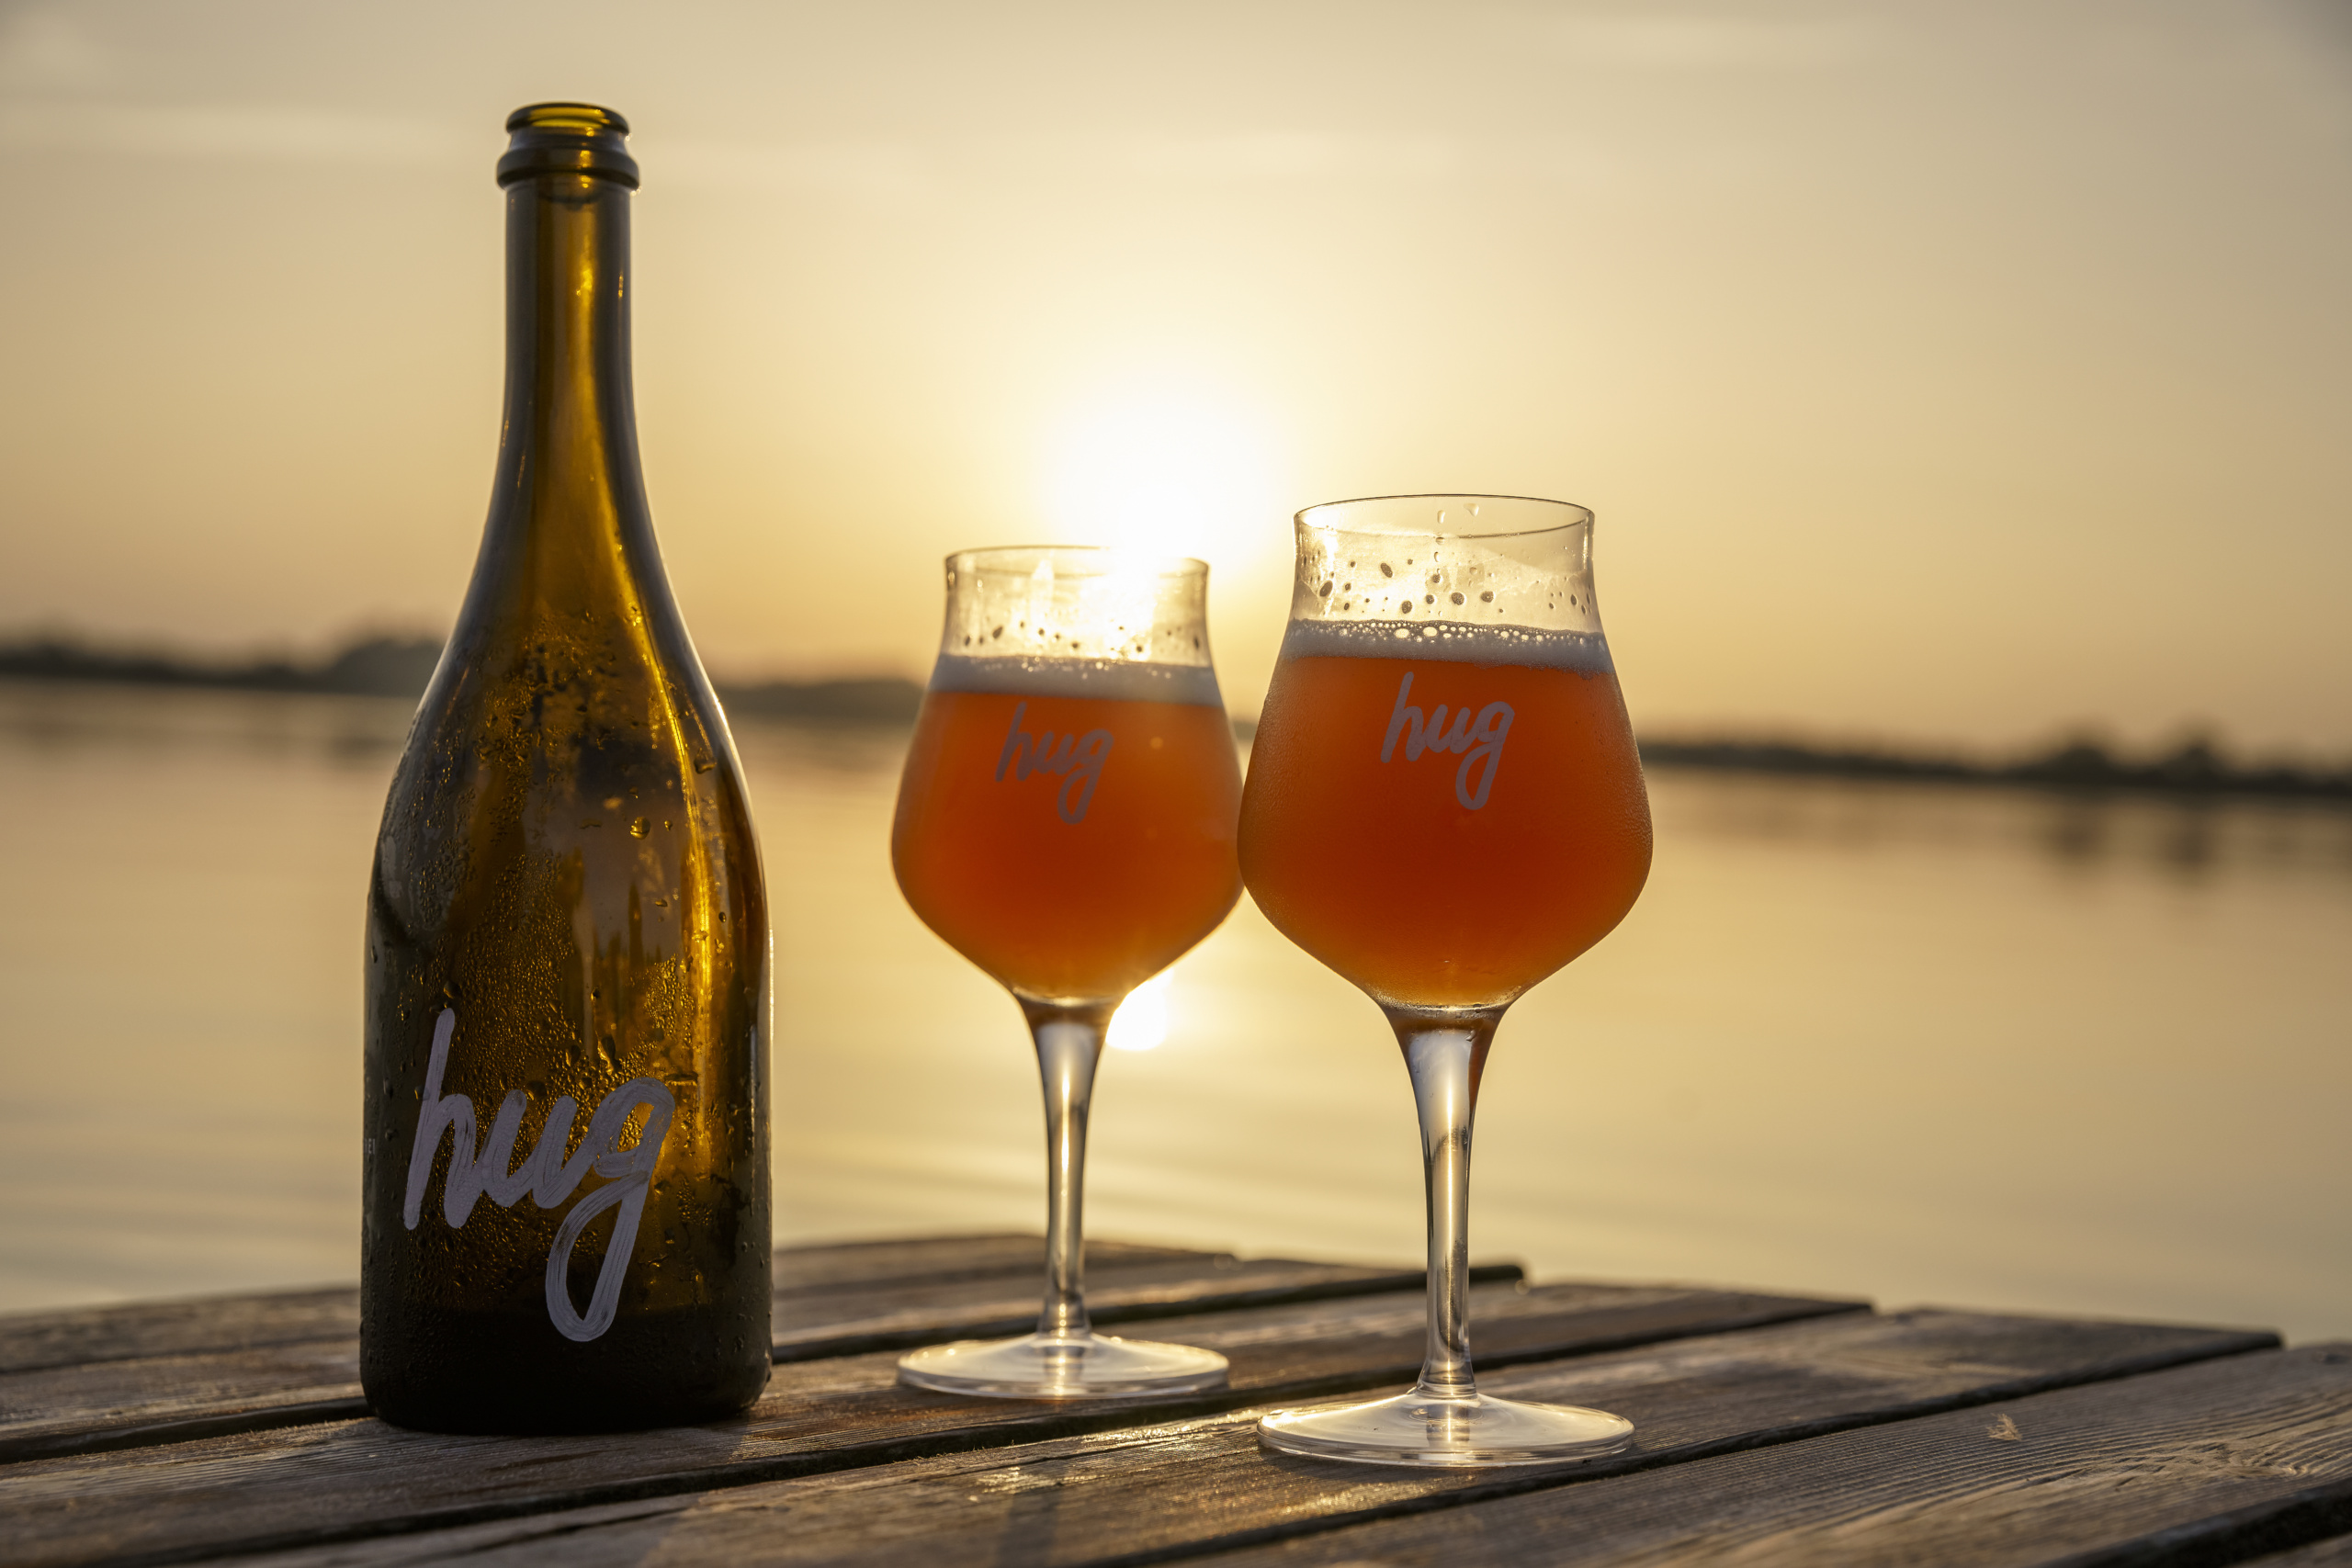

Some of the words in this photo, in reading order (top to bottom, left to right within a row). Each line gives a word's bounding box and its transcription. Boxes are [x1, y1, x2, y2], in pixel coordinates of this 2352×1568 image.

[994, 701, 1114, 825] hug
[1380, 671, 1515, 810] hug
[403, 1008, 676, 1342] hug
